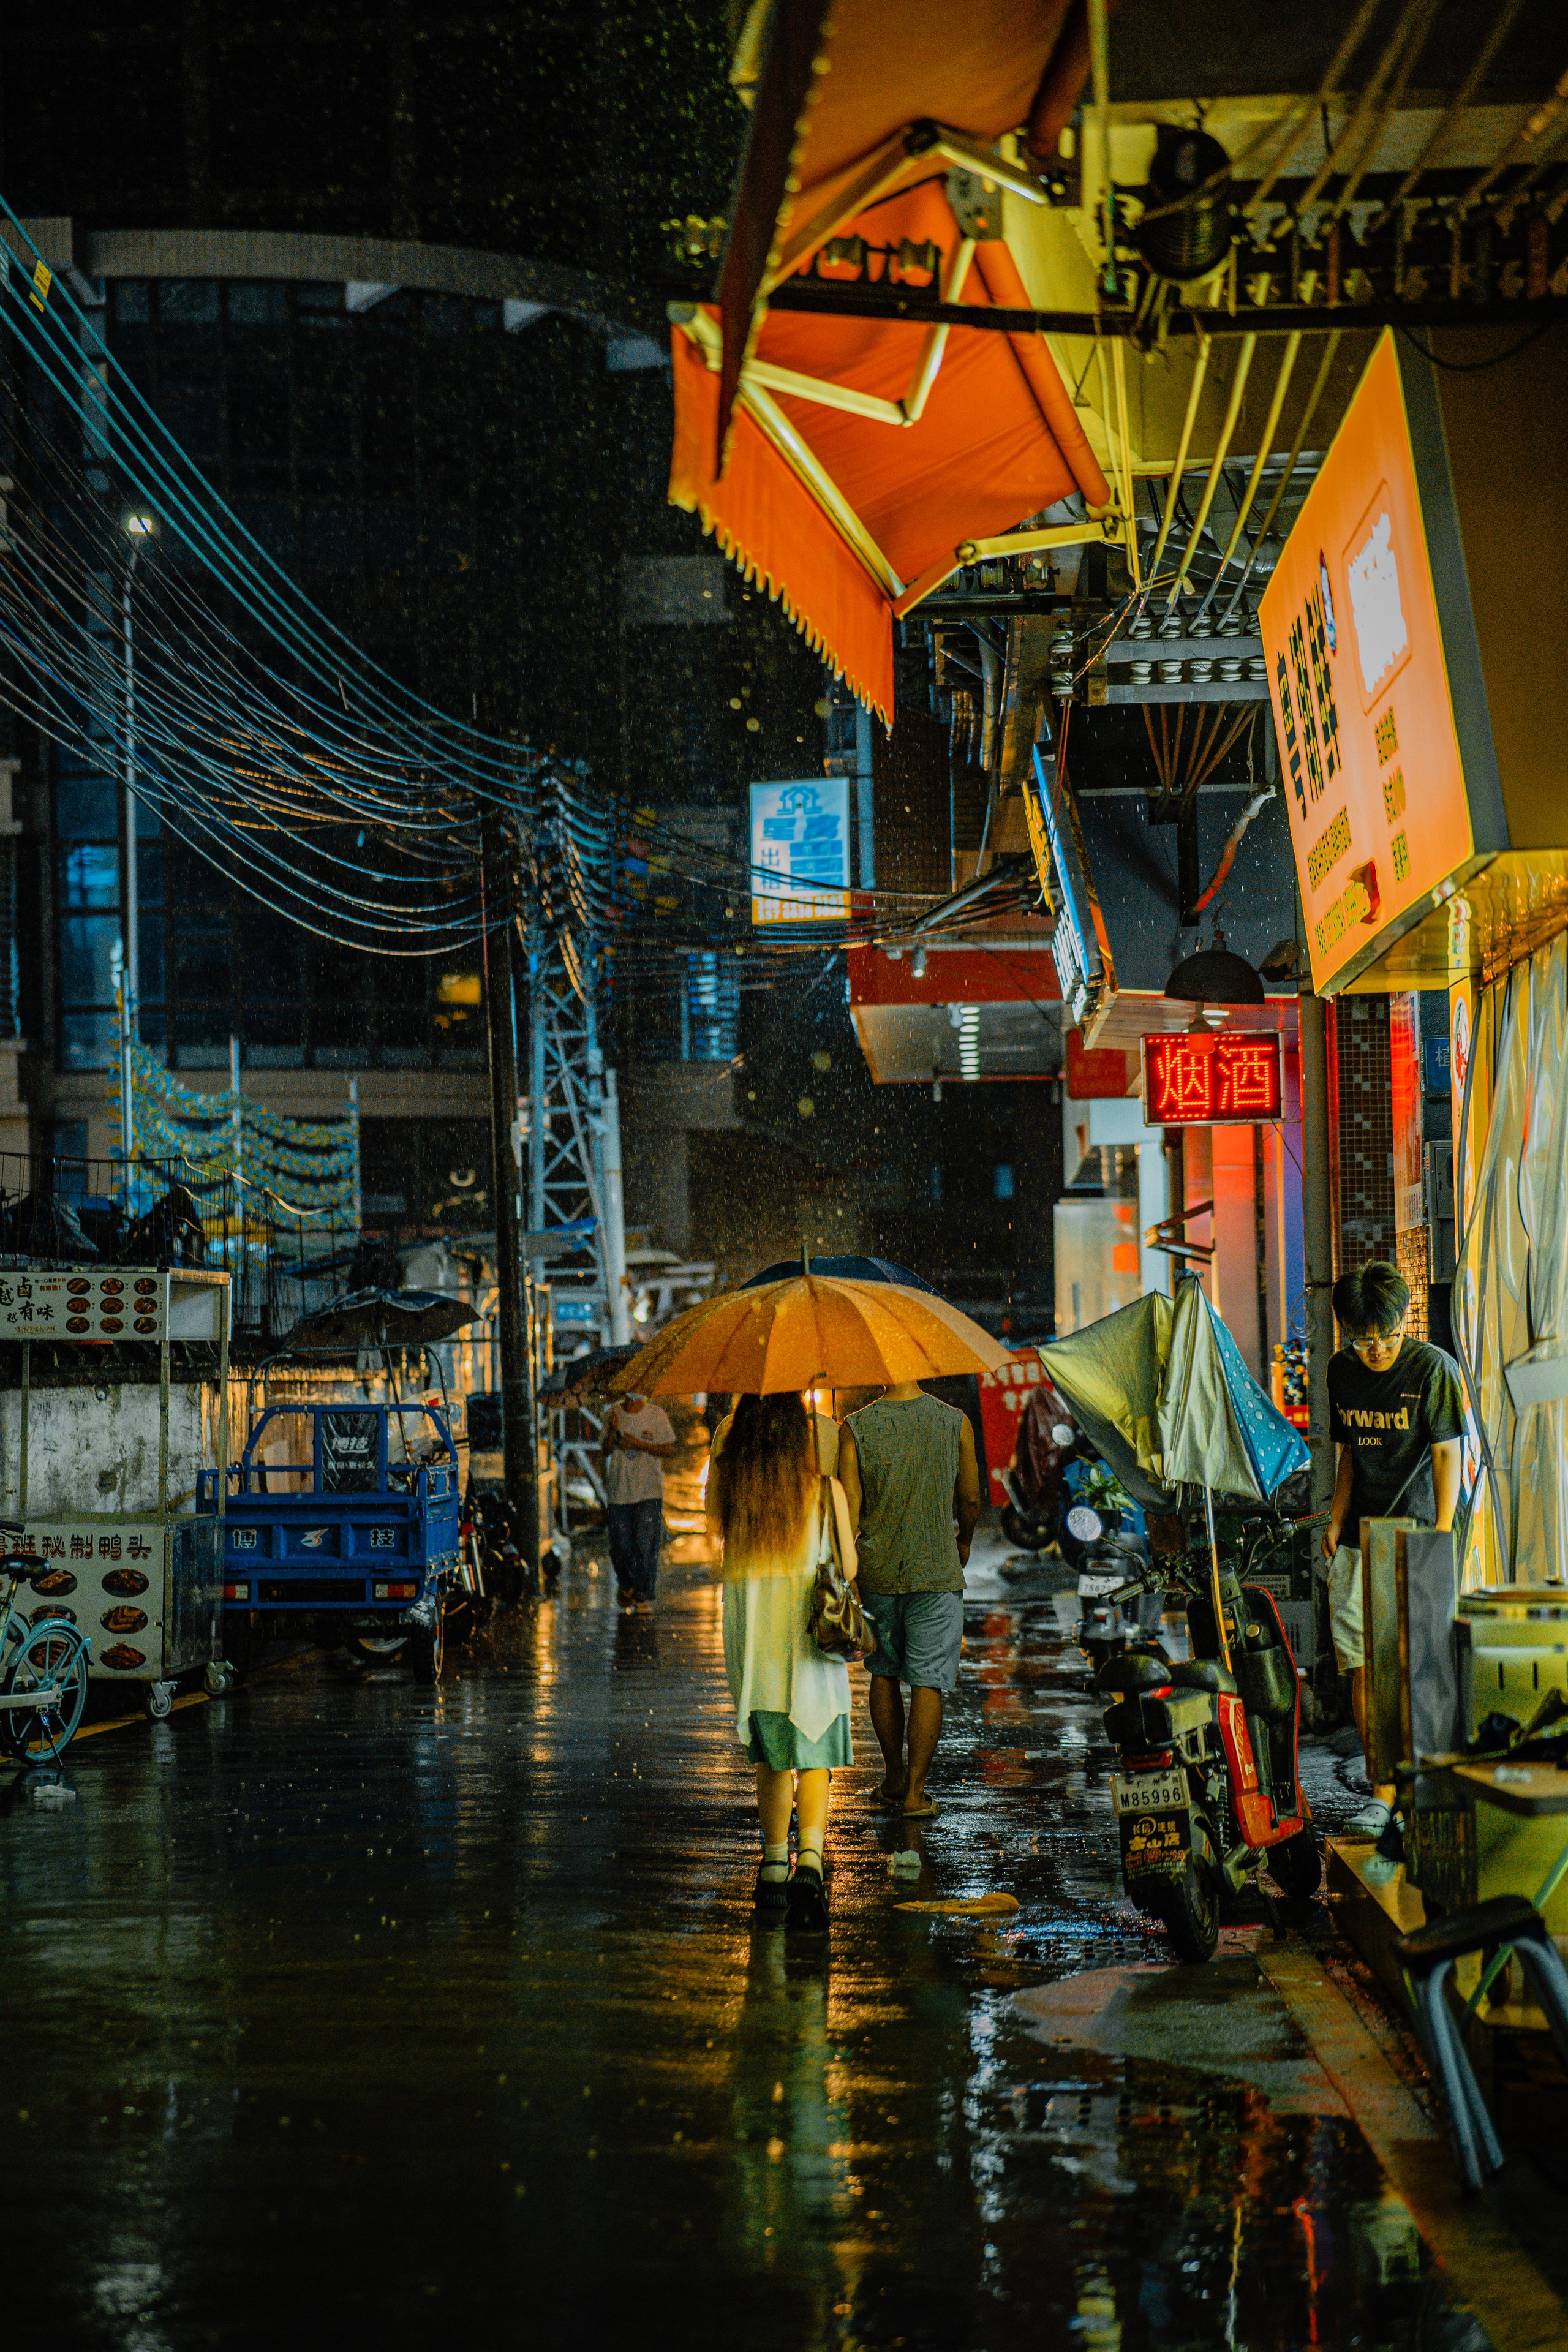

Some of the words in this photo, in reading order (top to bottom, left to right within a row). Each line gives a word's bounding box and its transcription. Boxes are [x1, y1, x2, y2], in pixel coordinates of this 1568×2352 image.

[1156, 1043, 1273, 1110] 烟酒
[1336, 1403, 1409, 1430] orward
[1358, 1437, 1382, 1446] LOOK
[233, 1529, 257, 1549] 博
[370, 1529, 394, 1548] 技
[1120, 1787, 1181, 1808] M85996
